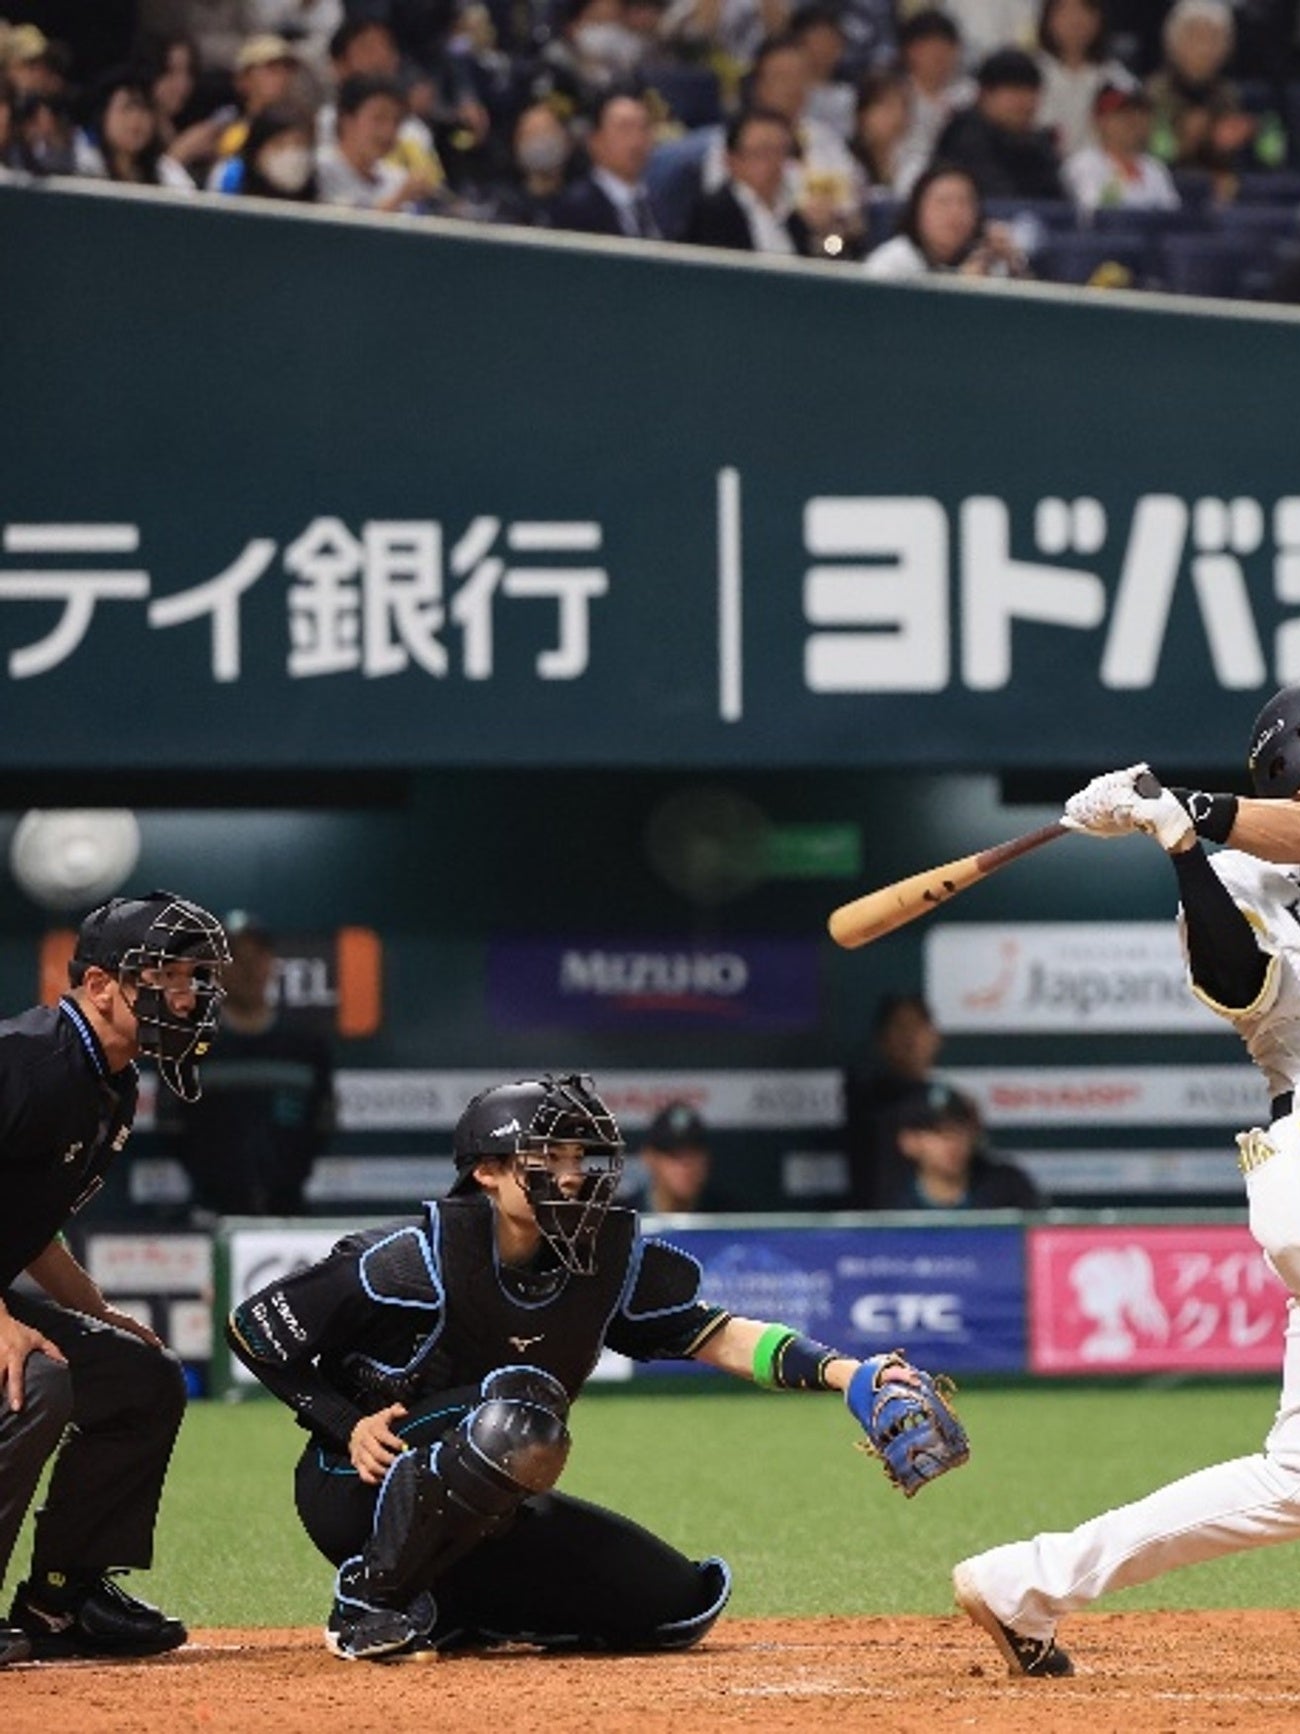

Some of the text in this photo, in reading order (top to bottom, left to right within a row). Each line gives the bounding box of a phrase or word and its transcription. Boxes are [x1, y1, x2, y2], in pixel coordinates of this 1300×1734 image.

[0, 516, 608, 682] ティ銀行
[559, 950, 750, 994] MIZUHO
[851, 1294, 962, 1333] CTC
